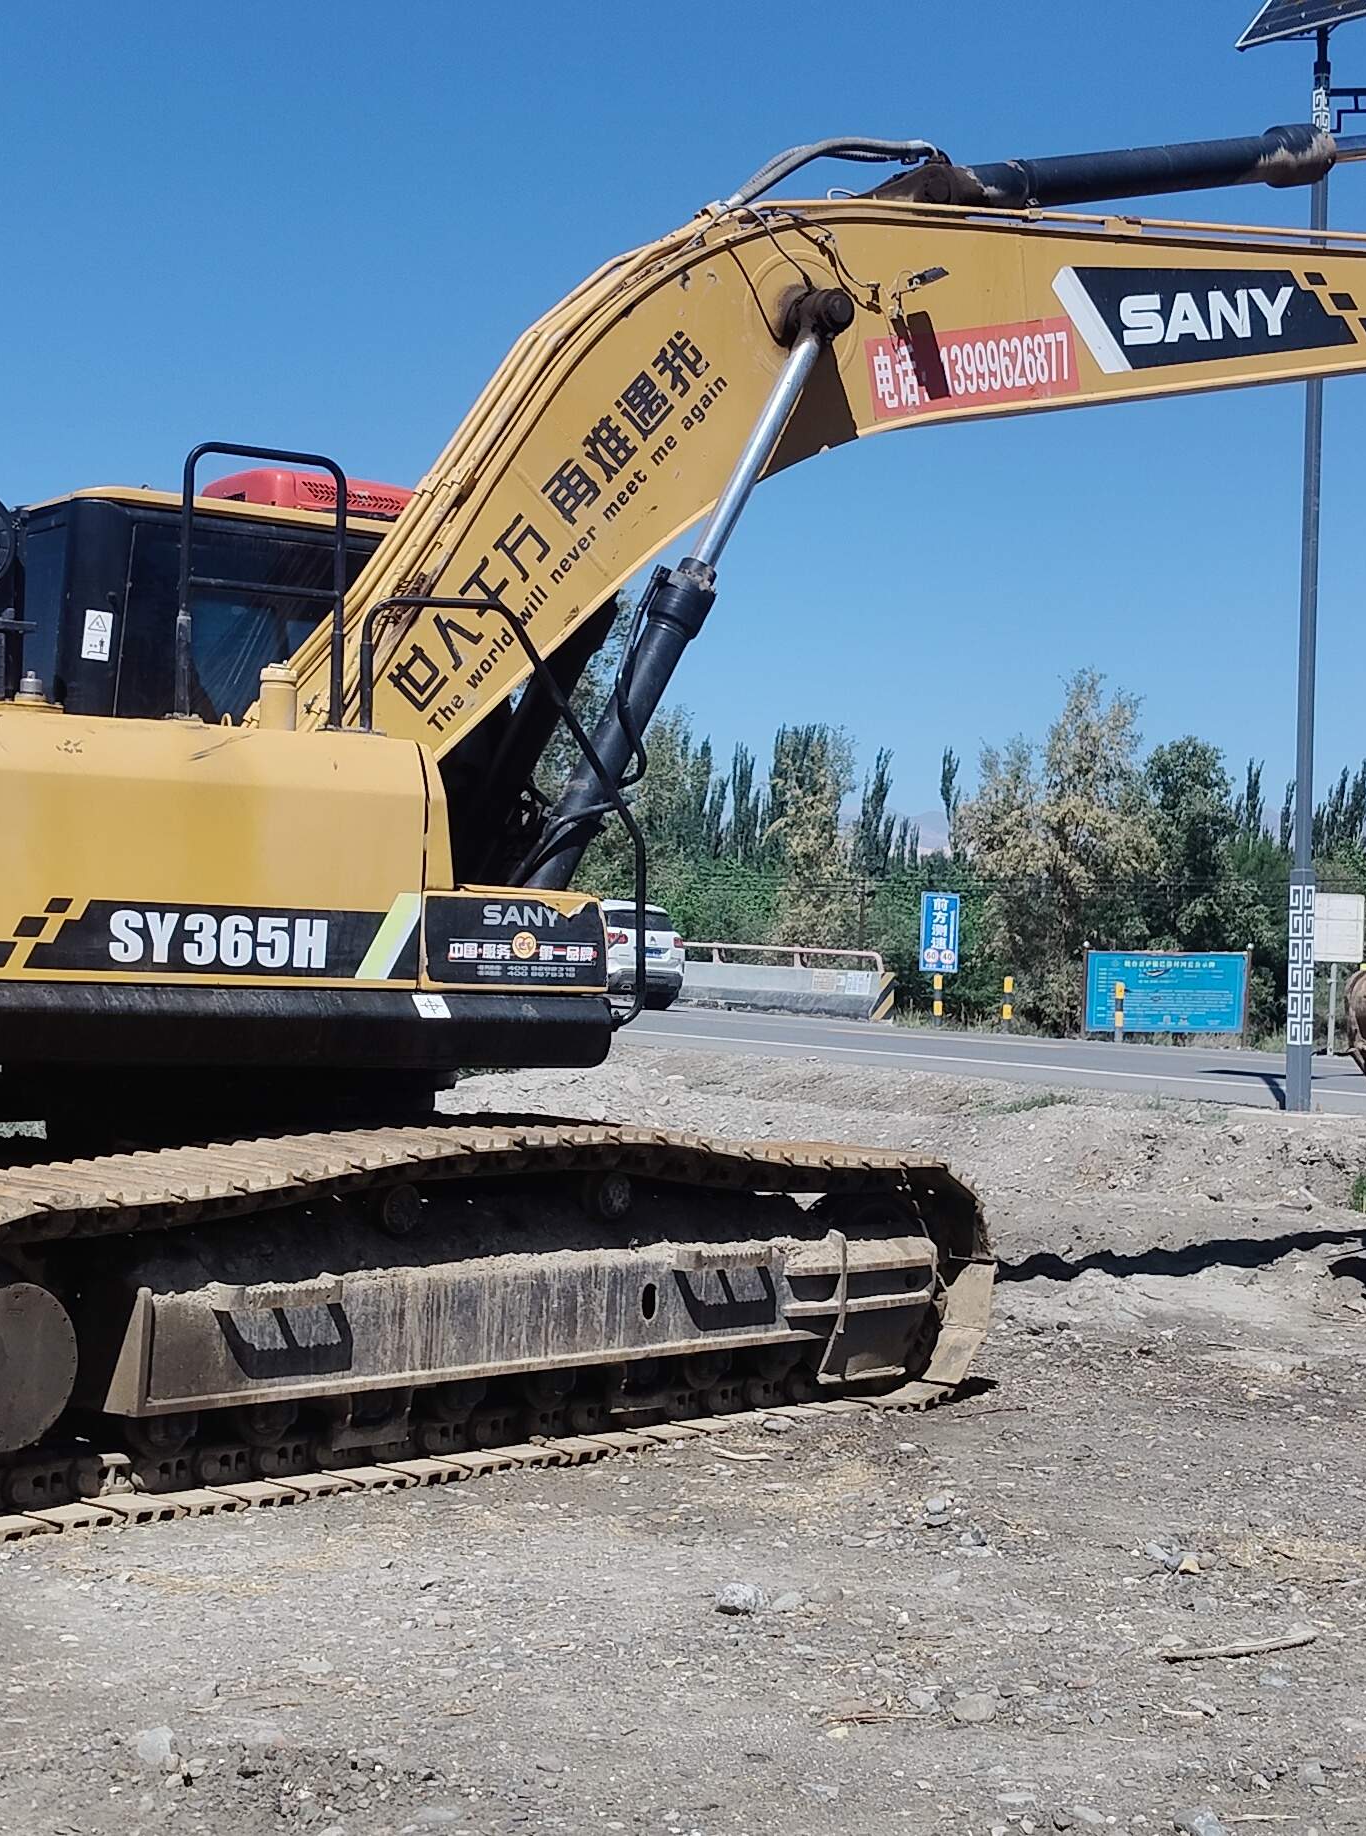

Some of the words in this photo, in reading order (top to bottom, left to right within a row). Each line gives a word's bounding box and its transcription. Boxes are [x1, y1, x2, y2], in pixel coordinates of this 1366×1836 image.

[1119, 285, 1295, 346] SANY
[940, 330, 1069, 399] 13999626877
[387, 512, 551, 712] 世人千万
[541, 330, 710, 526] 再难遇我
[427, 694, 465, 732] The
[465, 627, 516, 689] world
[517, 584, 549, 627] will
[550, 527, 597, 585] never
[603, 469, 648, 522] meet
[650, 434, 678, 466] me
[680, 373, 729, 432] again
[108, 908, 329, 969] SY365H
[482, 904, 559, 928] SANY
[930, 897, 949, 950] 前方测速
[943, 953, 952, 961] 40
